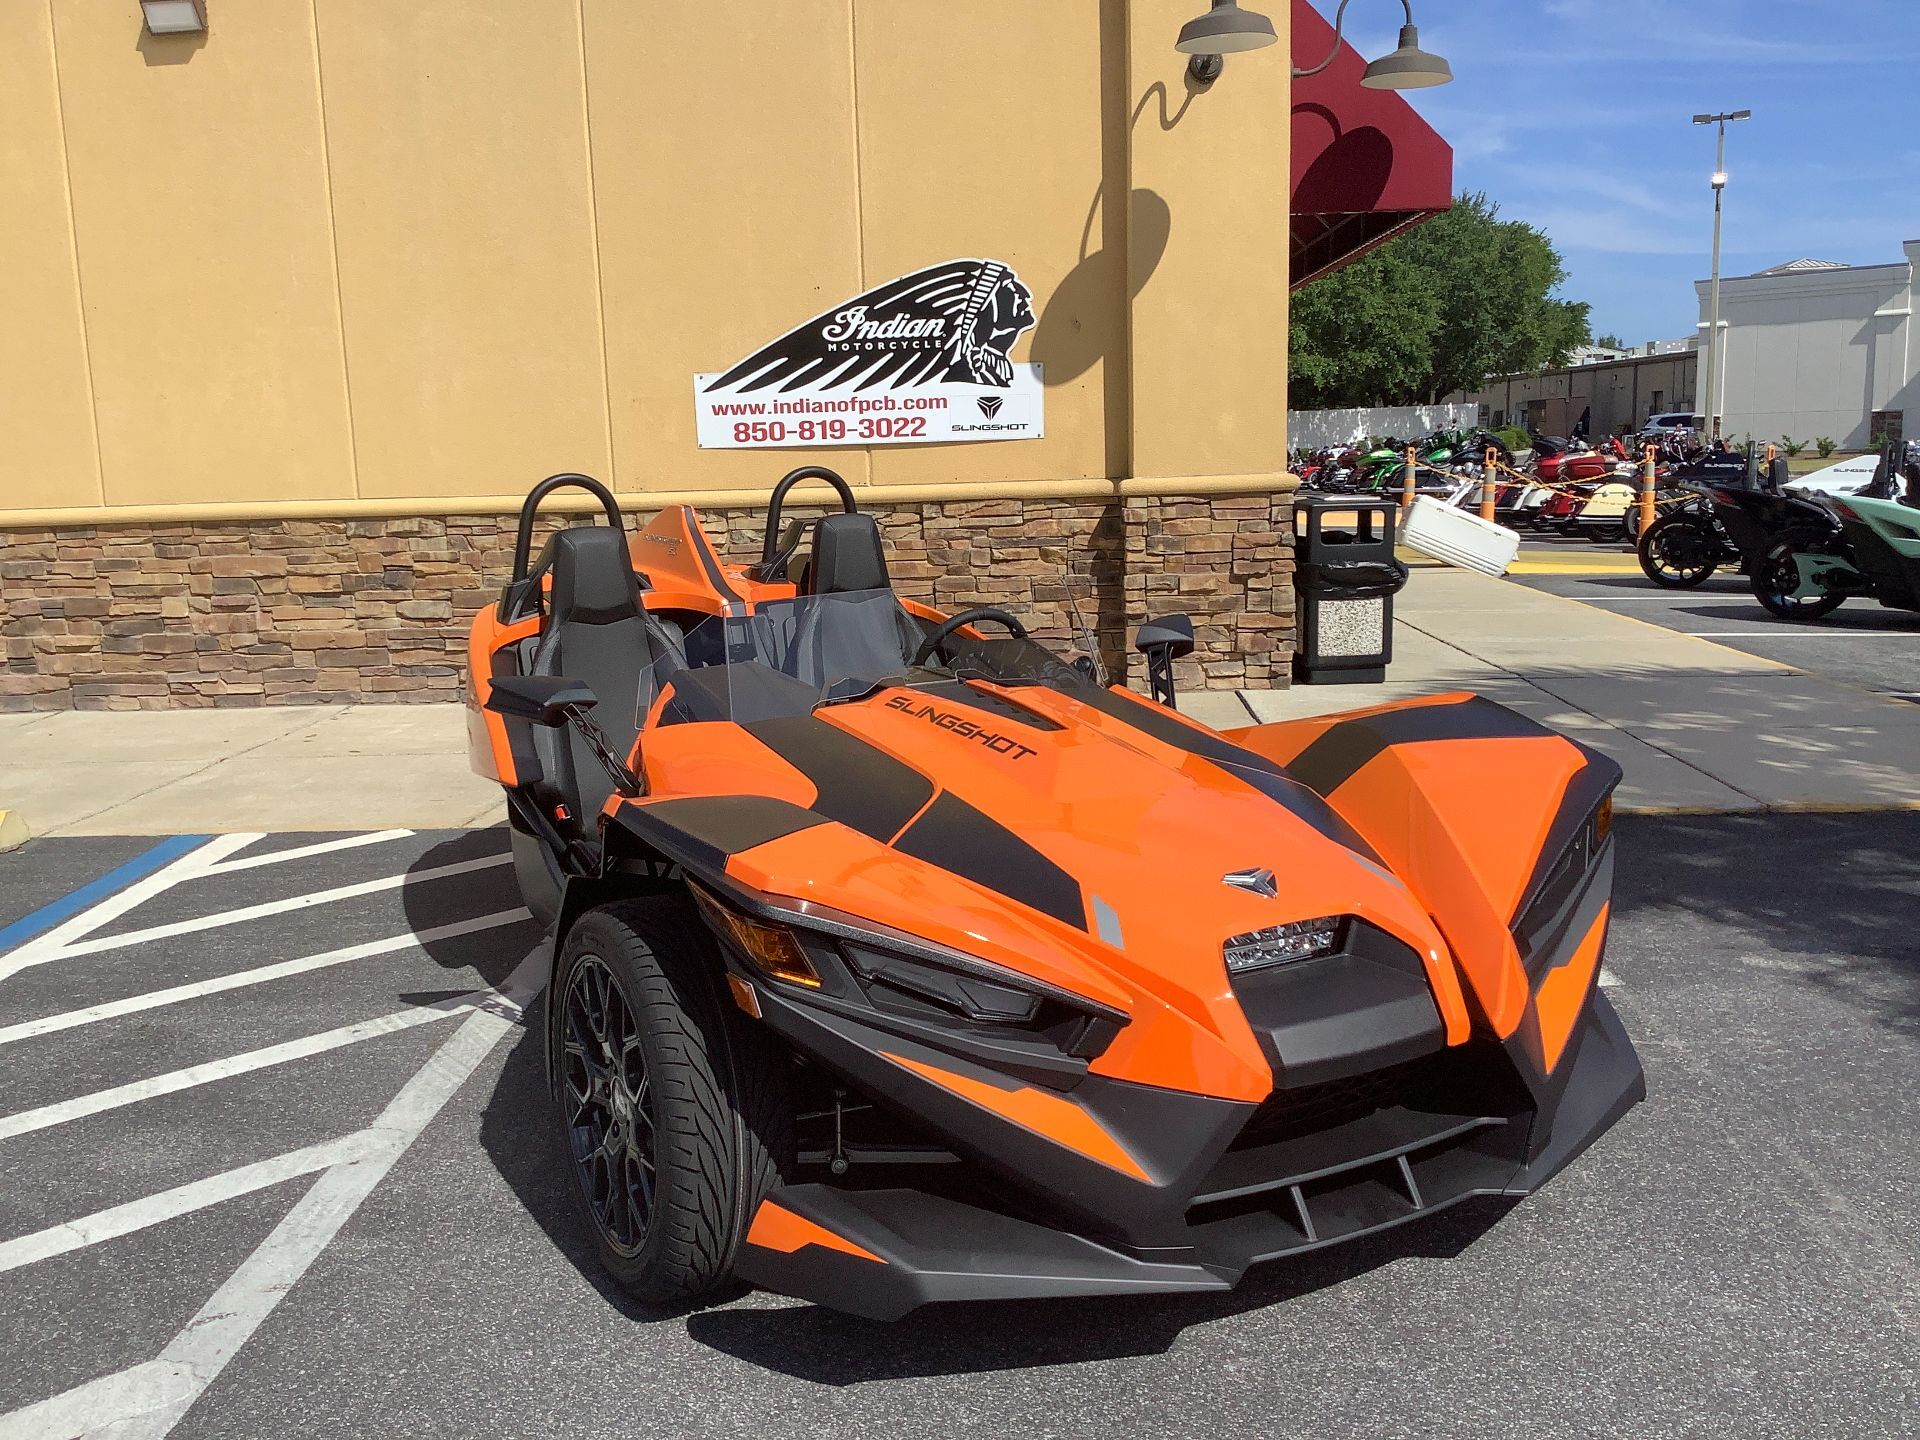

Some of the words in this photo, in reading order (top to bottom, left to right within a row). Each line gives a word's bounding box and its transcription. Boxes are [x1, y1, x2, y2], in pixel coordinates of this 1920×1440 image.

[822, 306, 945, 341] Indian
[828, 340, 941, 351] MOTORCYCLE
[711, 396, 948, 415] www.indianofpcb.com
[733, 416, 927, 442] 850-819-3022
[951, 423, 1029, 431] SLINGSHOT
[884, 696, 1038, 760] SLINGSHOT
